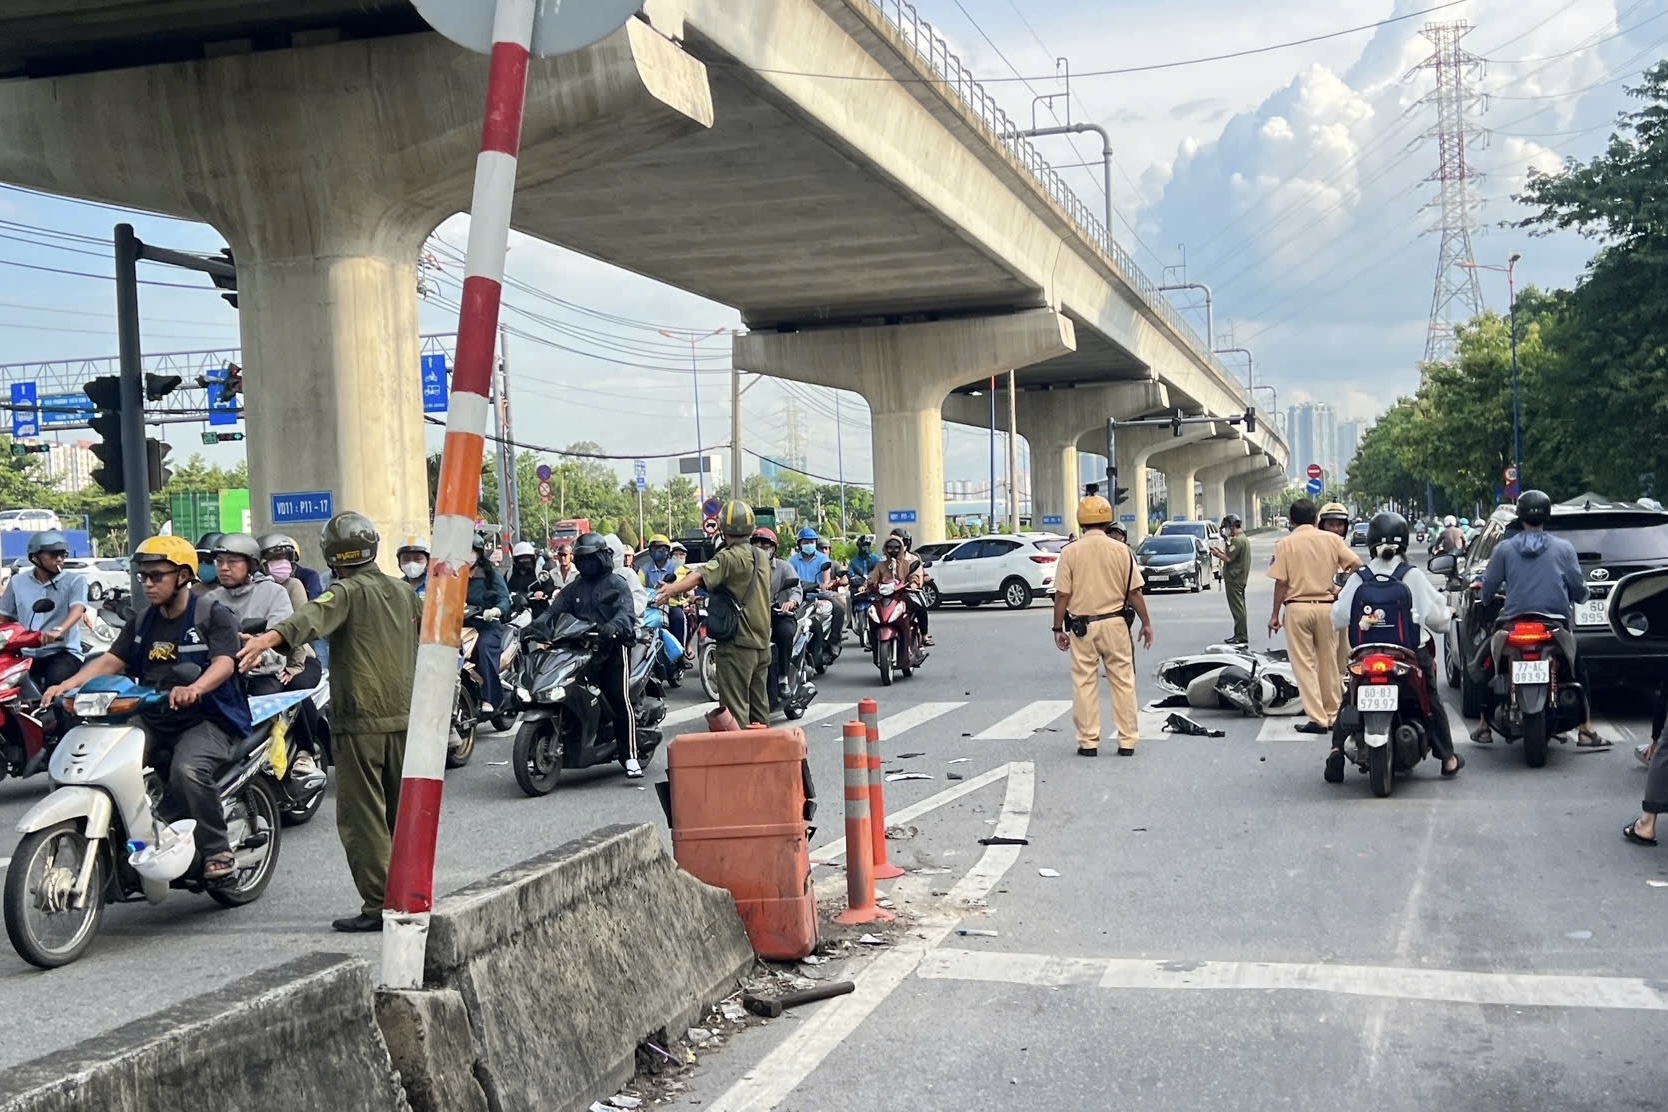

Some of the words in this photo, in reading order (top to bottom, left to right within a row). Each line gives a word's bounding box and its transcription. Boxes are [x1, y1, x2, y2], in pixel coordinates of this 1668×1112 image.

[300, 501, 312, 514] P11
[320, 500, 328, 513] 17
[1360, 698, 1395, 709] 579.97
